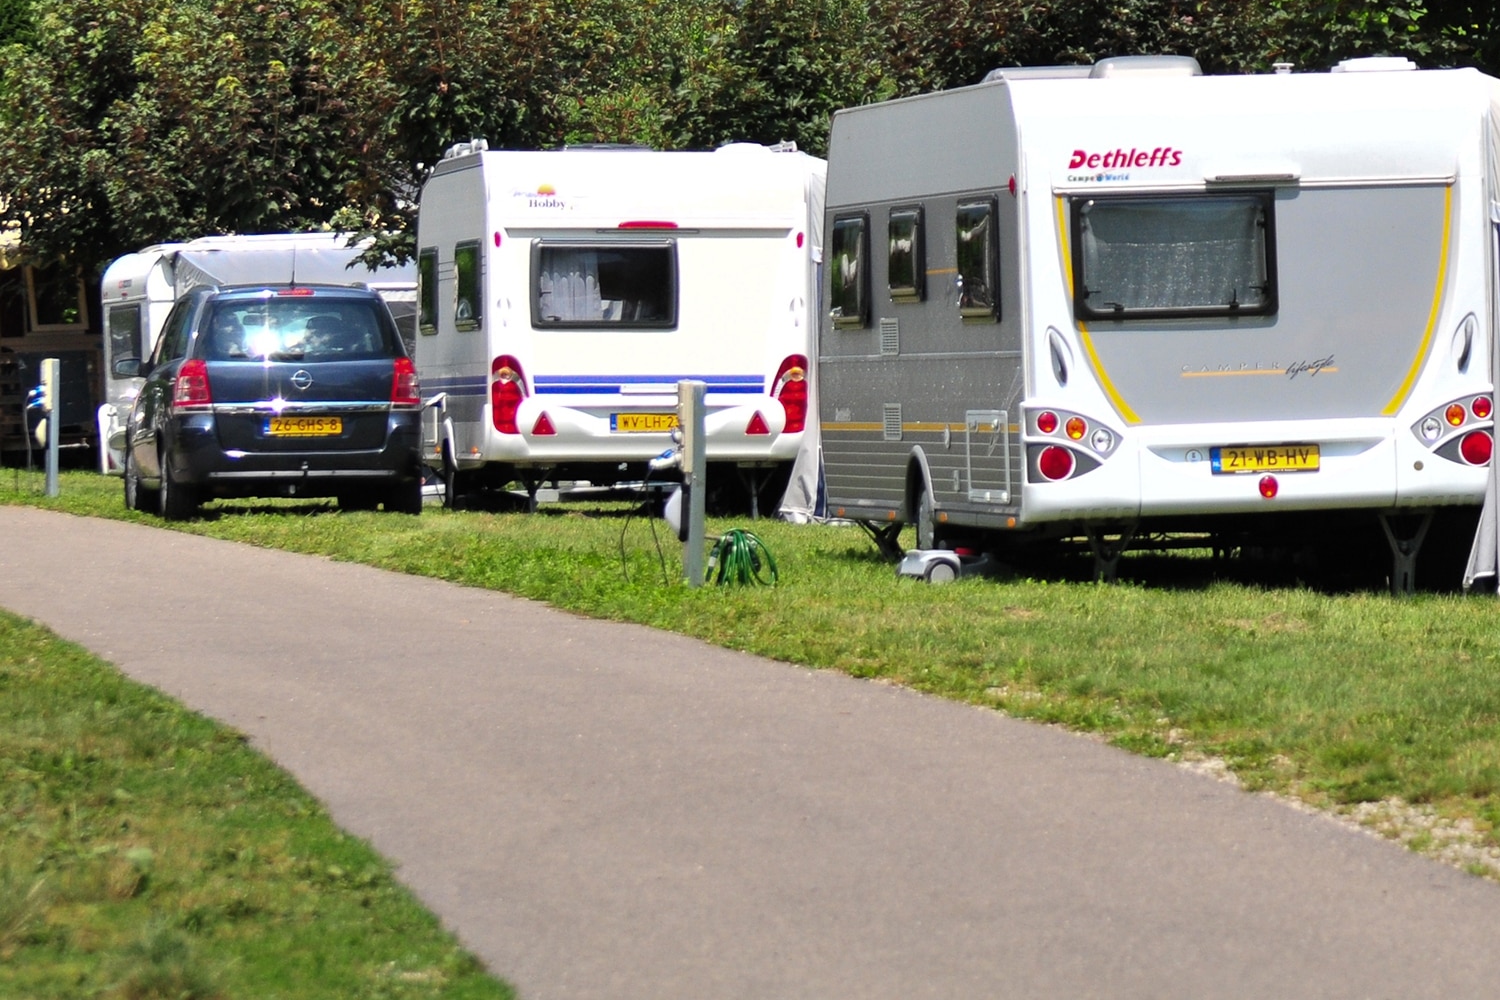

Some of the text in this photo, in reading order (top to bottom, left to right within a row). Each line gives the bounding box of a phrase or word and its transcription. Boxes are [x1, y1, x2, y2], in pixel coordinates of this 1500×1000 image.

[1068, 147, 1182, 169] Dethleffs
[529, 199, 565, 210] Hobby
[275, 419, 338, 431] 26-GHS-8
[1229, 448, 1310, 468] 21-WB-HV
